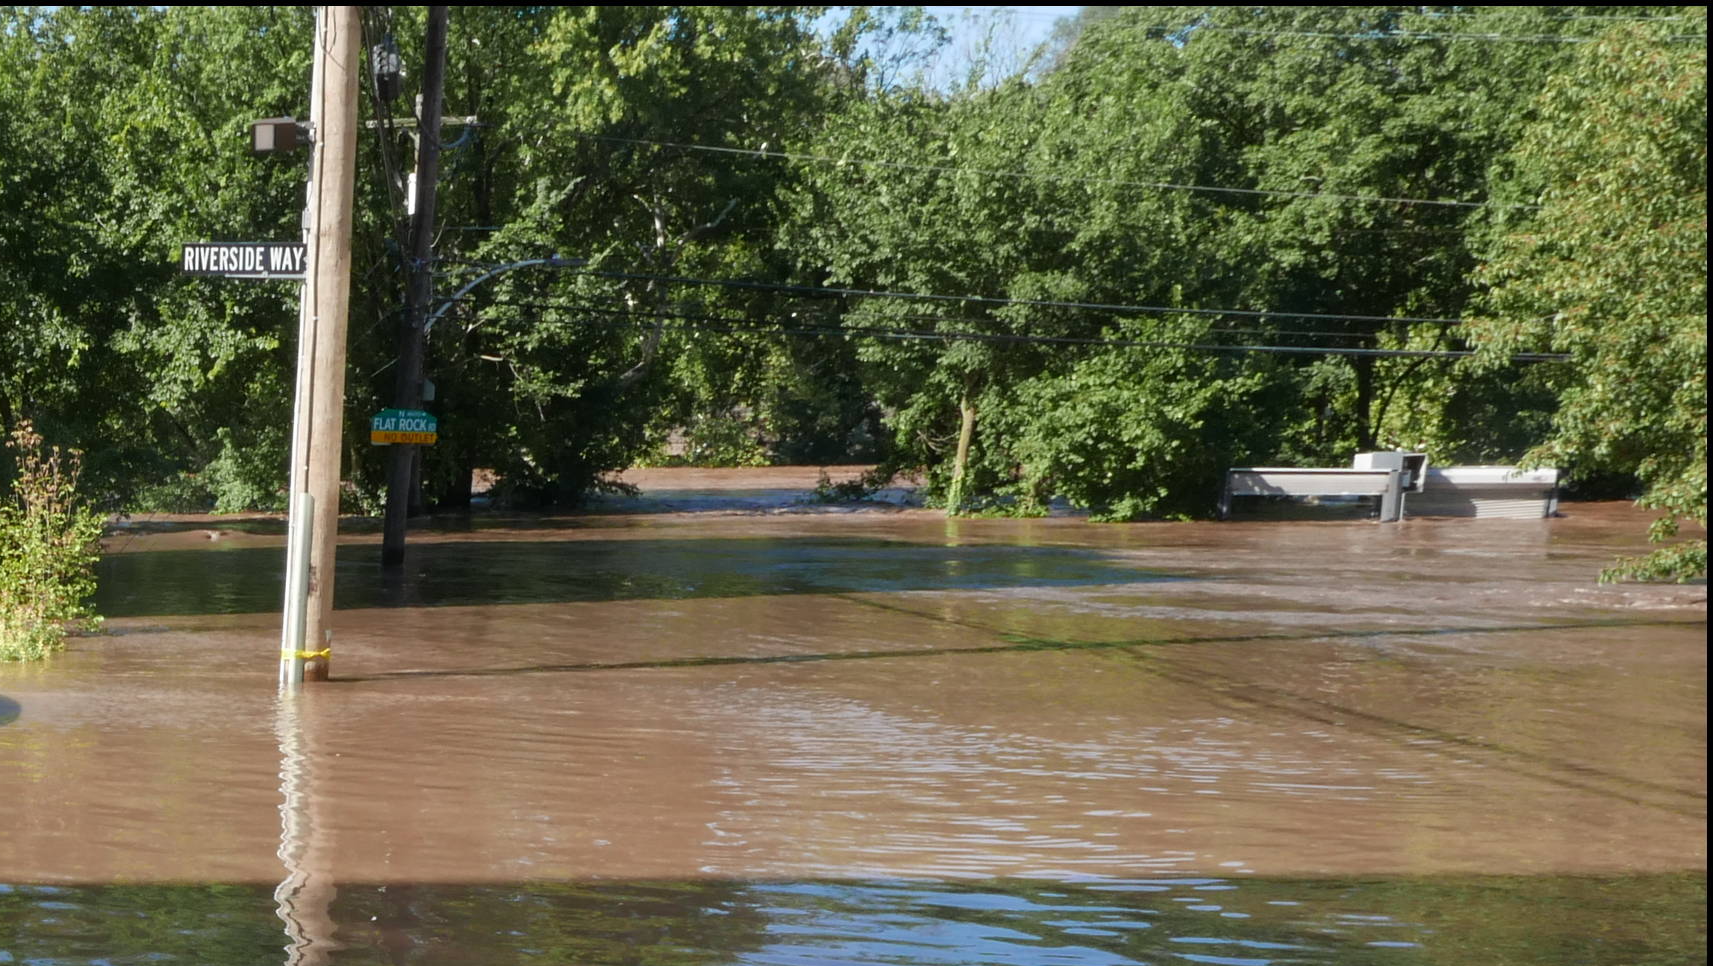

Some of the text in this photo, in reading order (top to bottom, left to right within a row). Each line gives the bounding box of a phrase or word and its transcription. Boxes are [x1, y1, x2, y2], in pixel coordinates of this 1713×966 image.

[184, 246, 303, 271] RIVERSIDE WAY
[373, 418, 396, 430] FLAT
[399, 418, 427, 432] ROCK
[384, 433, 433, 442] NO OUTLET
